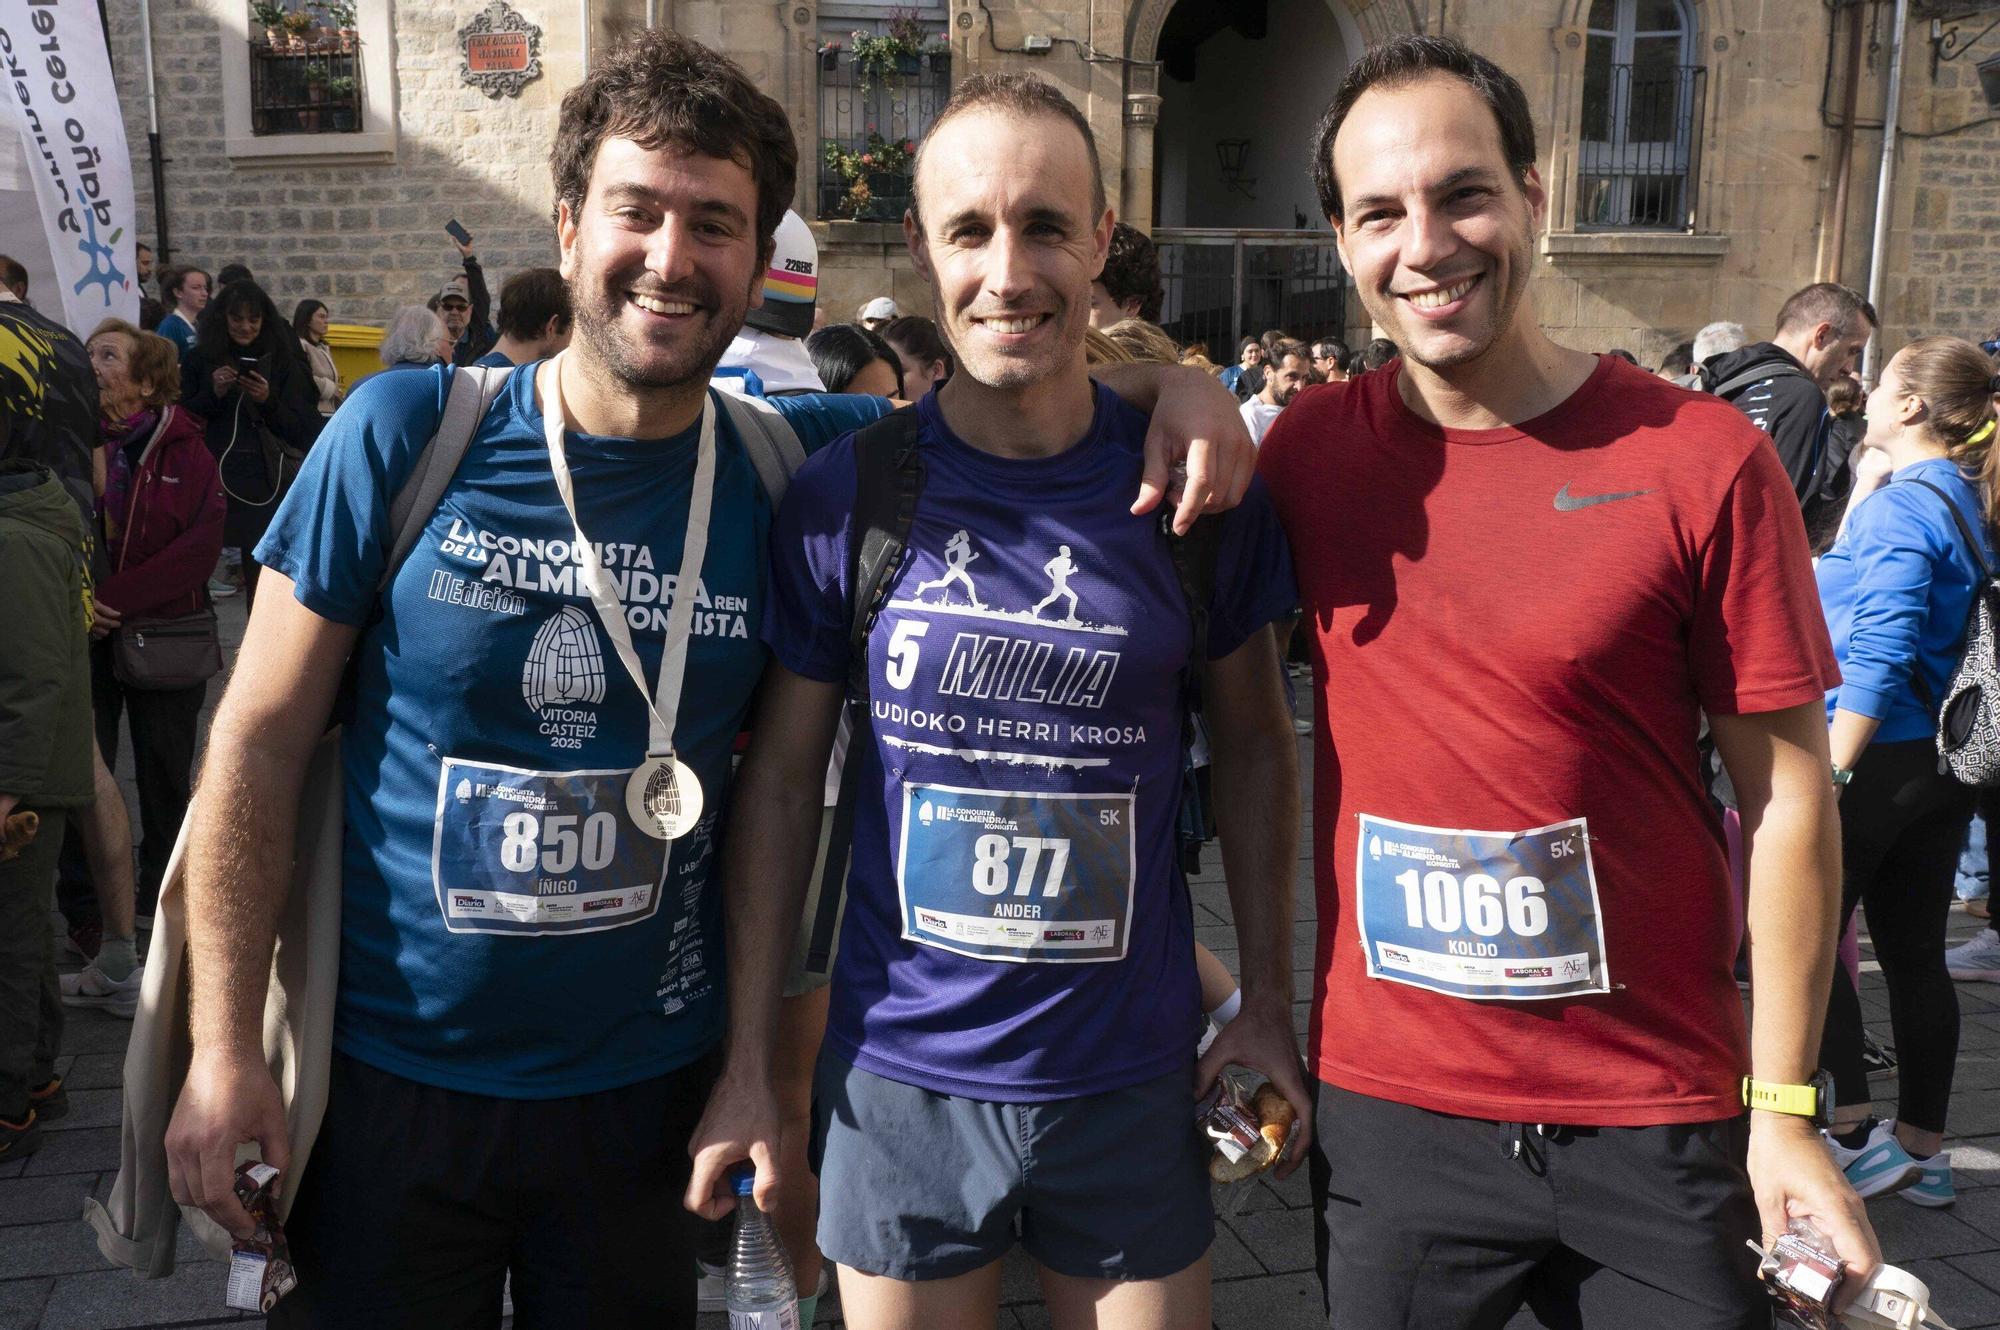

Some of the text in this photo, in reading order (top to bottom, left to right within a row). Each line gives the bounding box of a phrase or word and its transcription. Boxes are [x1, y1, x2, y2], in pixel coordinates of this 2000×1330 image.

[785, 258, 814, 274] 226ERS
[447, 518, 478, 546] LA
[439, 539, 467, 557] DE
[466, 546, 488, 563] LA
[714, 594, 749, 613] REN
[885, 618, 1121, 709] 5 MILIA
[540, 707, 598, 725] VITORIA
[870, 701, 1146, 745] UDIOKO HERRI KROSA
[538, 722, 597, 739] GASTEIZ
[550, 736, 582, 750] 2025
[497, 792, 547, 805] ALMENDRA
[956, 808, 996, 817] CONQUISTA
[958, 814, 1008, 825] ALMENDRA
[1099, 809, 1121, 826] 5K
[500, 810, 618, 874] 850
[1549, 839, 1575, 859] 5K
[971, 833, 1071, 898] 877
[537, 878, 579, 895] ÍÑIGO
[1395, 867, 1549, 937] 1066
[992, 903, 1042, 920] ANDER
[1448, 939, 1498, 958] KOLDO
